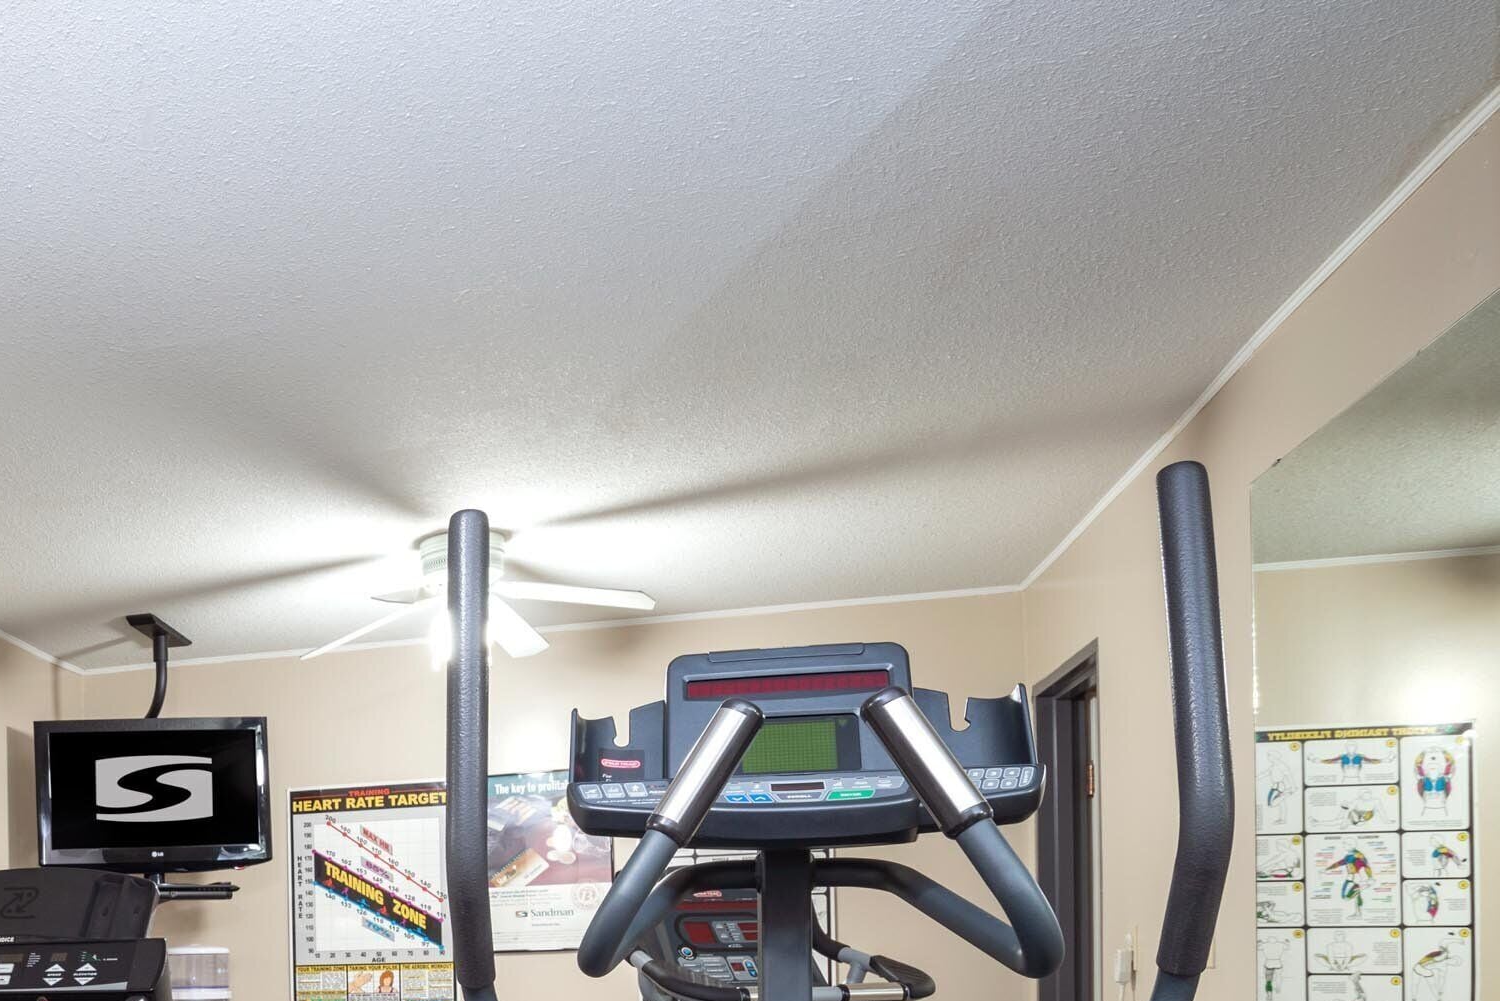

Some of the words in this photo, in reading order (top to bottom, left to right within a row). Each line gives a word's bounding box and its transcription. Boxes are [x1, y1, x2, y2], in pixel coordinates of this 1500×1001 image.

[348, 788, 390, 797] TRAINING
[494, 783, 509, 795] The
[511, 783, 525, 795] key
[527, 781, 536, 792] to
[292, 798, 341, 812] HEART
[346, 795, 385, 809] RATE
[388, 791, 447, 807] TARGET
[362, 826, 378, 844] MAX
[324, 860, 385, 907] TRAINING
[392, 898, 428, 930] ZONE
[530, 908, 574, 917] Sandman
